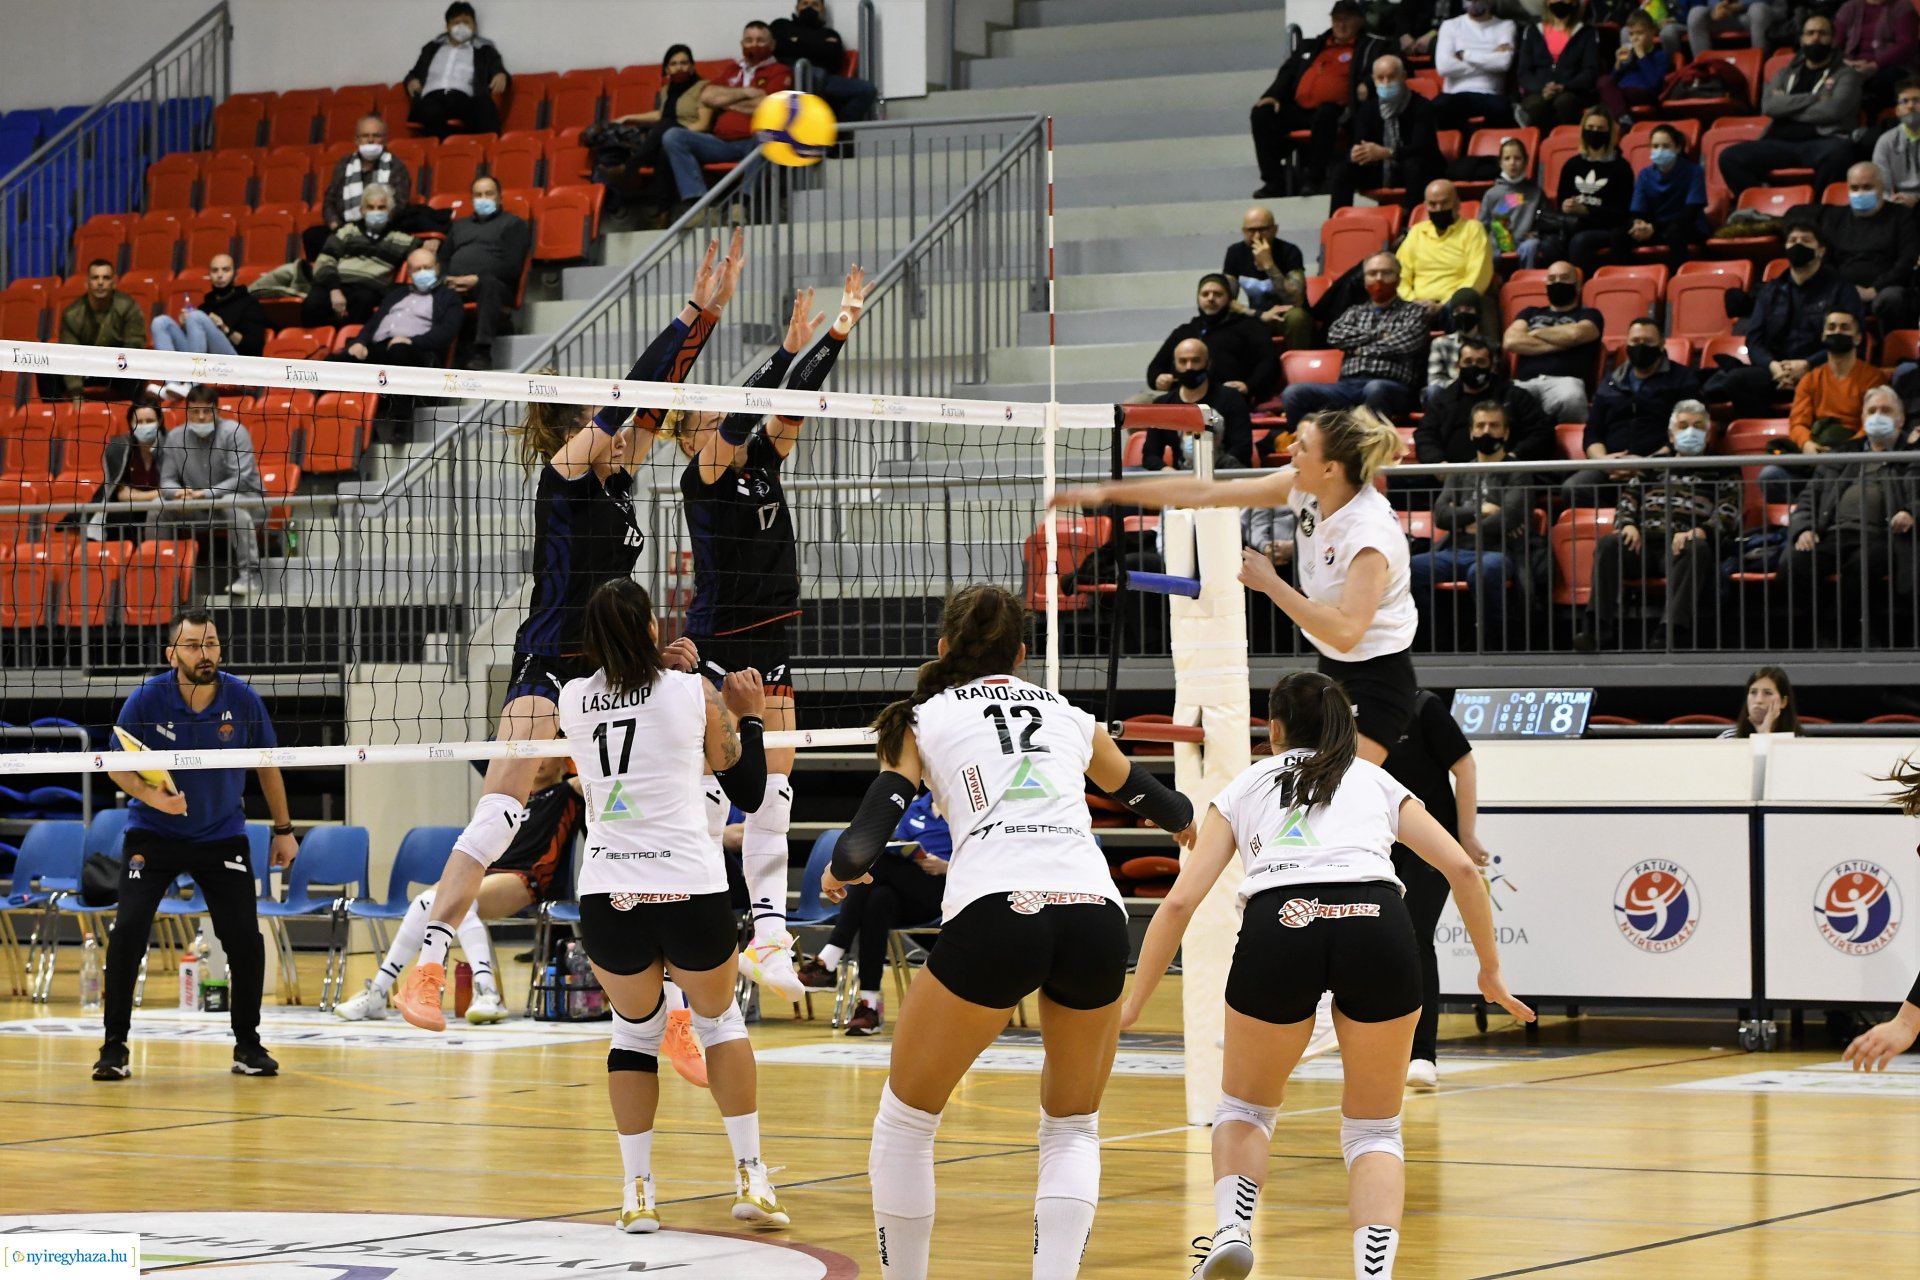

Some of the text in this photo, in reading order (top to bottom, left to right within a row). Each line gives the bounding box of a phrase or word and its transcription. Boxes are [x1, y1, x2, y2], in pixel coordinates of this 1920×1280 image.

[12, 348, 50, 366] FATUM
[285, 365, 318, 382] FATUM
[528, 381, 558, 396] FATUM
[745, 393, 772, 408] FATUM
[941, 404, 965, 418] FATUM
[757, 502, 780, 531] 17
[1545, 691, 1592, 704] FATUM
[1462, 703, 1574, 733] 9 8
[983, 704, 1051, 755] 12
[429, 746, 453, 758] FATUM
[592, 718, 636, 777] 17
[174, 753, 202, 766] FATUM
[972, 766, 986, 812] STRABAG
[605, 850, 672, 860] BESTRONG
[1635, 861, 1678, 875] FATUM
[1836, 862, 1880, 877] FATUM
[1434, 923, 1530, 945] ÖPLBDA
[879, 1226, 890, 1267] MIKASA
